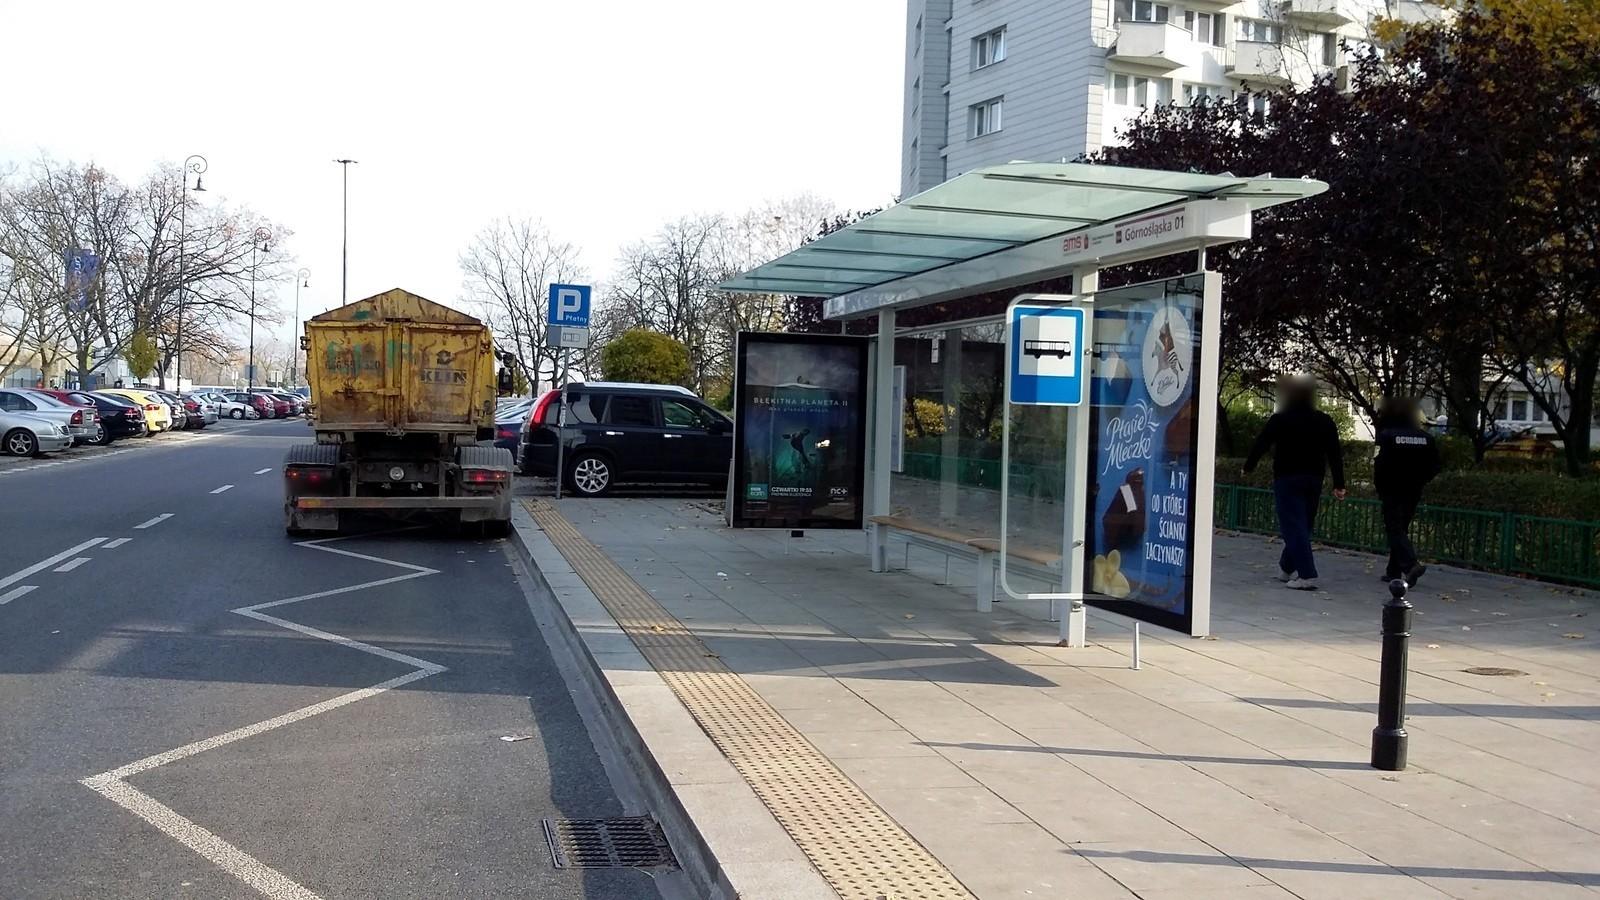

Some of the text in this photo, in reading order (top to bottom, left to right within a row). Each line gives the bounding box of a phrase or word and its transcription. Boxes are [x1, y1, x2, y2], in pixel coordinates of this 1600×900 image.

[1124, 220, 1172, 242] Górnośląska
[1174, 215, 1184, 231] 01
[1063, 236, 1082, 252] ams
[557, 288, 582, 321] P
[420, 369, 467, 383] KLIN
[800, 398, 839, 407] PLANETA
[1395, 436, 1427, 445] OCHRONA
[1170, 471, 1187, 491] A TY
[1152, 493, 1186, 517] OD KTÓREJ
[1159, 517, 1186, 542] ŚCIANKI
[1145, 542, 1184, 567] ZACZYNASZ?
